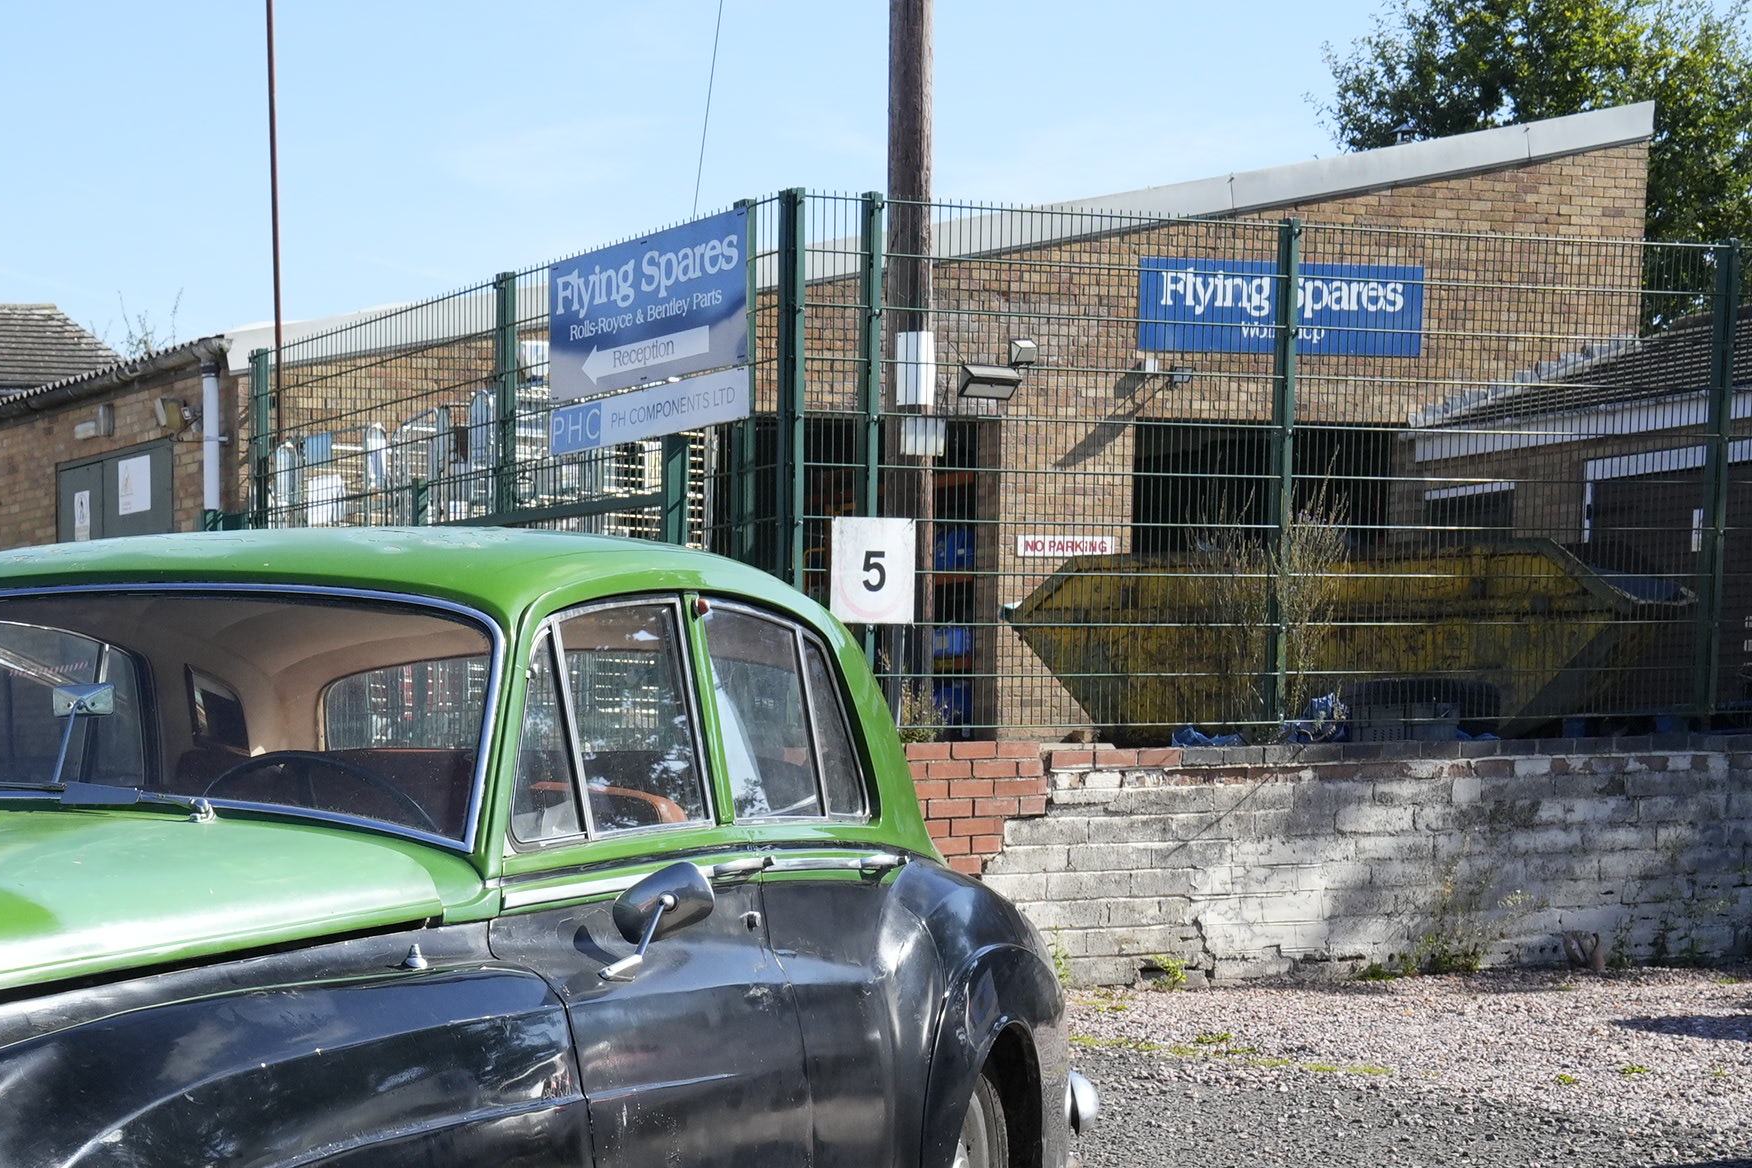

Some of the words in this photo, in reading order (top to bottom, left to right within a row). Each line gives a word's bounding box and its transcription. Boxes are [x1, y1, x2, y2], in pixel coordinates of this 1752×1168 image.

[556, 259, 635, 318] Flying
[641, 234, 738, 298] Spares
[1161, 267, 1271, 317] Flying
[1297, 279, 1404, 318] pares
[570, 313, 632, 341] Rolls-Royce
[636, 308, 644, 324] &
[648, 297, 690, 322] Bentley
[693, 289, 722, 310] Parts
[613, 340, 675, 367] Reception
[553, 408, 600, 447] PHC
[610, 410, 626, 428] PH
[629, 393, 709, 425] COMPONENTS
[713, 387, 736, 410] LTD
[1025, 540, 1045, 552] NO
[1048, 540, 1107, 553] PARKING
[862, 551, 886, 592] 5
